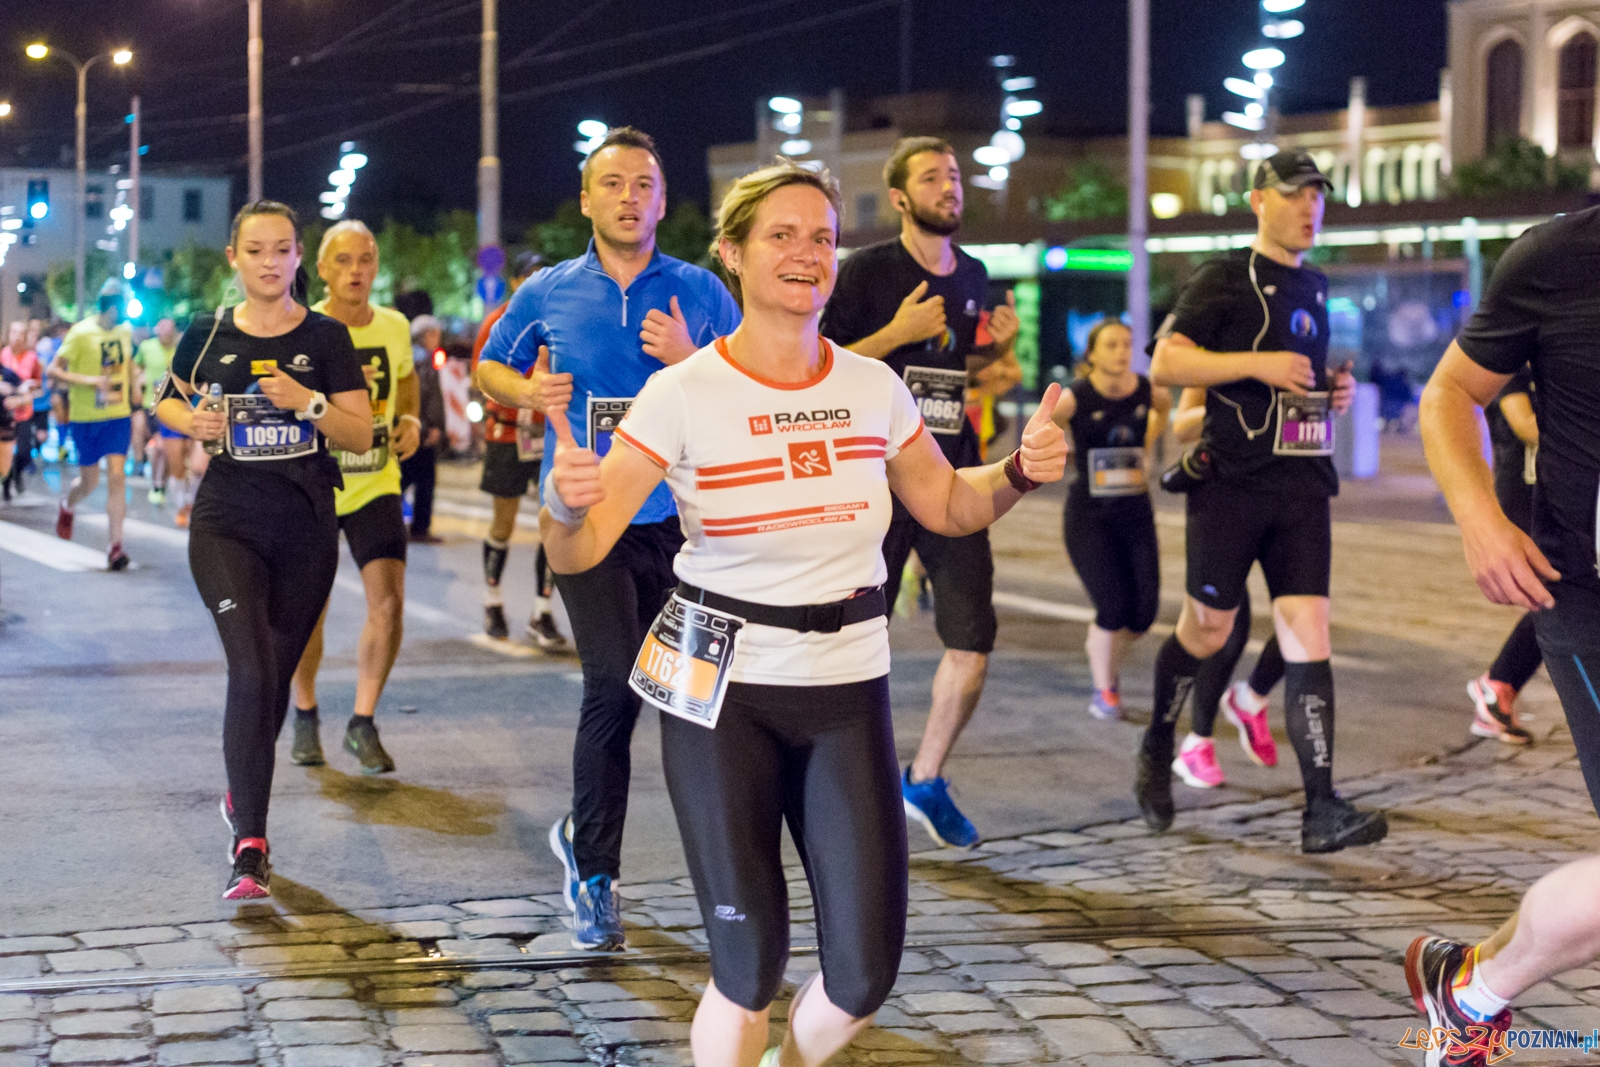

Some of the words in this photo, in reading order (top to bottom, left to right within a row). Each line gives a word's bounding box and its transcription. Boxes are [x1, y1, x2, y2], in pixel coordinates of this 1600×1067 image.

[774, 408, 850, 424] RADIO
[916, 397, 961, 420] 10662
[245, 425, 301, 446] 10970
[777, 420, 851, 433] WROCŁAW
[823, 503, 865, 512] BIEGAMY
[646, 642, 690, 688] 1762
